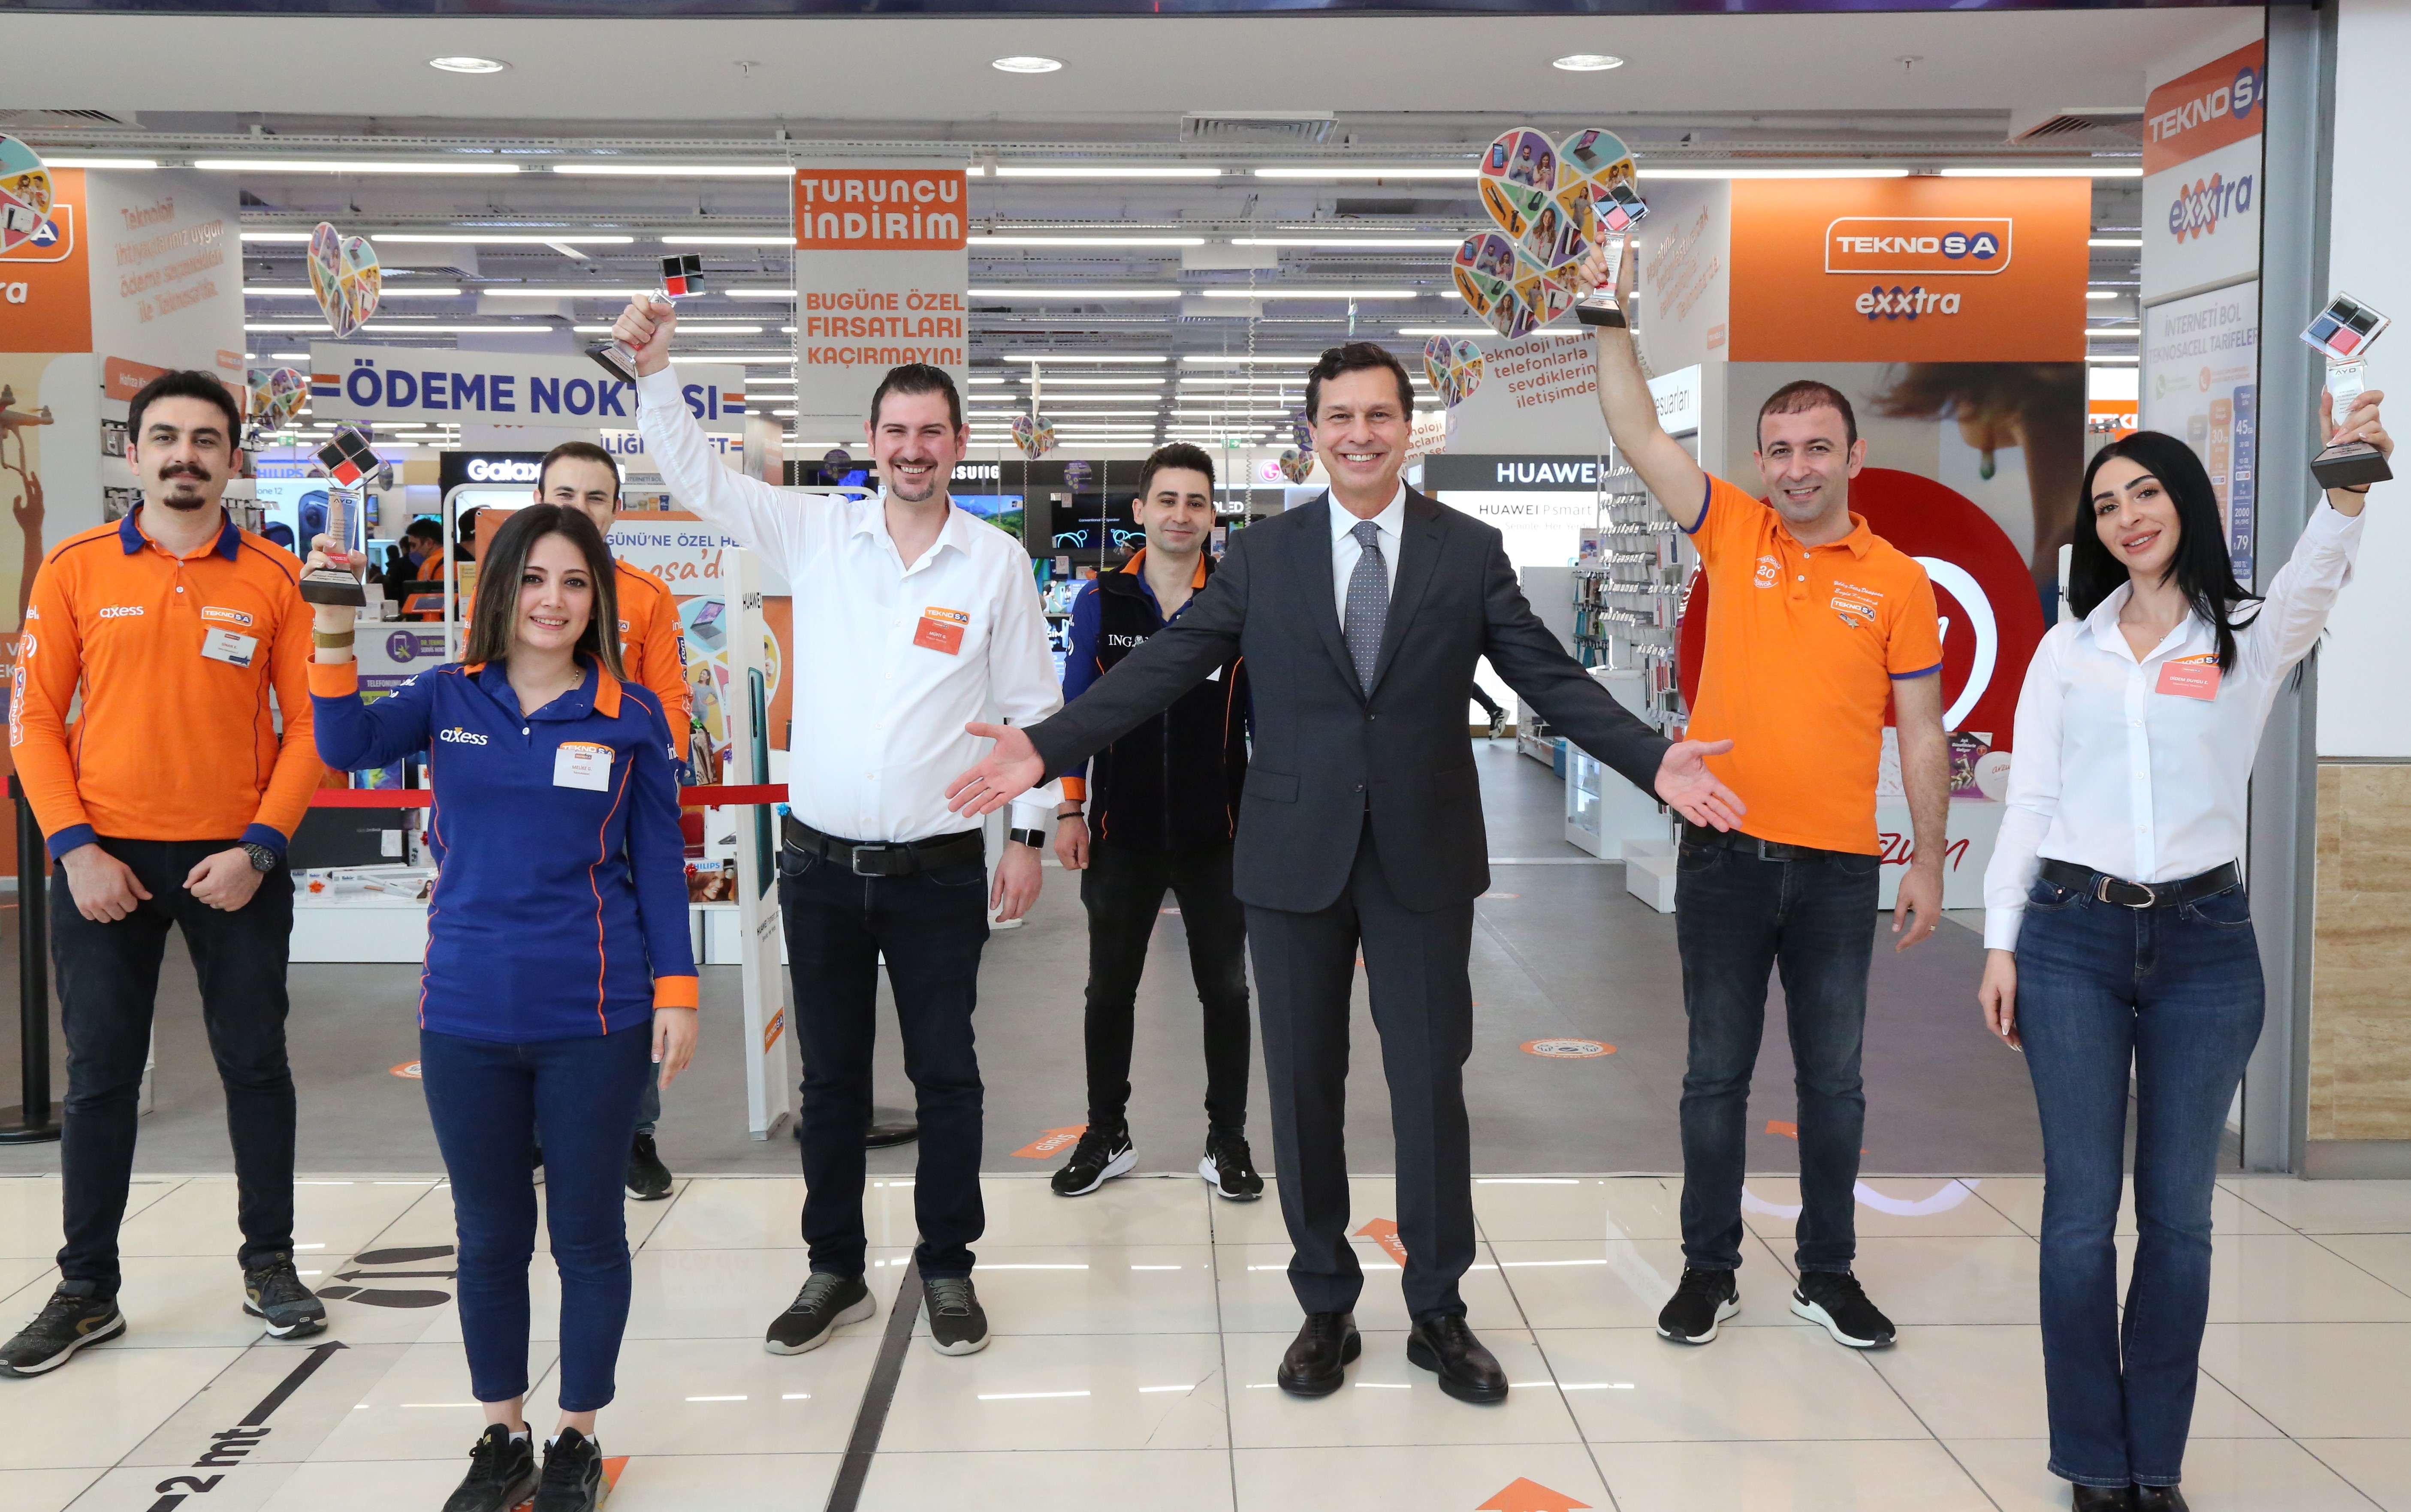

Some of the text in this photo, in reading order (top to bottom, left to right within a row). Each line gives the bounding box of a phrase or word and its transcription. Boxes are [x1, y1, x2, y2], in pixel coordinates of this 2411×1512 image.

[800, 179, 959, 202] TURUNCU
[2169, 174, 2252, 235] exxtra
[190, 218, 224, 246] uygun
[804, 204, 959, 239] İNDİRİM
[1837, 236, 1997, 254] TEKNOSA
[806, 289, 965, 311] BUGÜNE ÖZEL
[1856, 287, 1961, 315] exxtra
[807, 316, 962, 338] FIRSATLARI
[2165, 301, 2242, 337] İNTERNETİ BOL
[808, 346, 962, 369] KAÇIRMAYIN!
[2148, 337, 2207, 364] TEKNOSACELL
[1494, 348, 1588, 379] telefonlarla
[2335, 367, 2356, 376] AYD
[347, 358, 515, 413] ÖDEME
[1508, 364, 1597, 393] sevdiklerin
[1516, 381, 1597, 408] iletişimde
[1479, 504, 1539, 515] HUAWEI
[1545, 522, 1562, 530] Her
[677, 532, 715, 547] ÖZEL
[1756, 565, 1776, 578] 20
[99, 605, 144, 618] axess
[742, 592, 762, 611] HUAWEI
[1834, 600, 1874, 618] TEKNOSA
[205, 610, 249, 622] TEKNOSA
[927, 609, 968, 622] TEKNOSA
[1108, 634, 1132, 648] ING
[440, 728, 488, 746] axess
[1035, 1134, 1077, 1151] GİRİŞ
[154, 1426, 271, 1494] 2 mt
